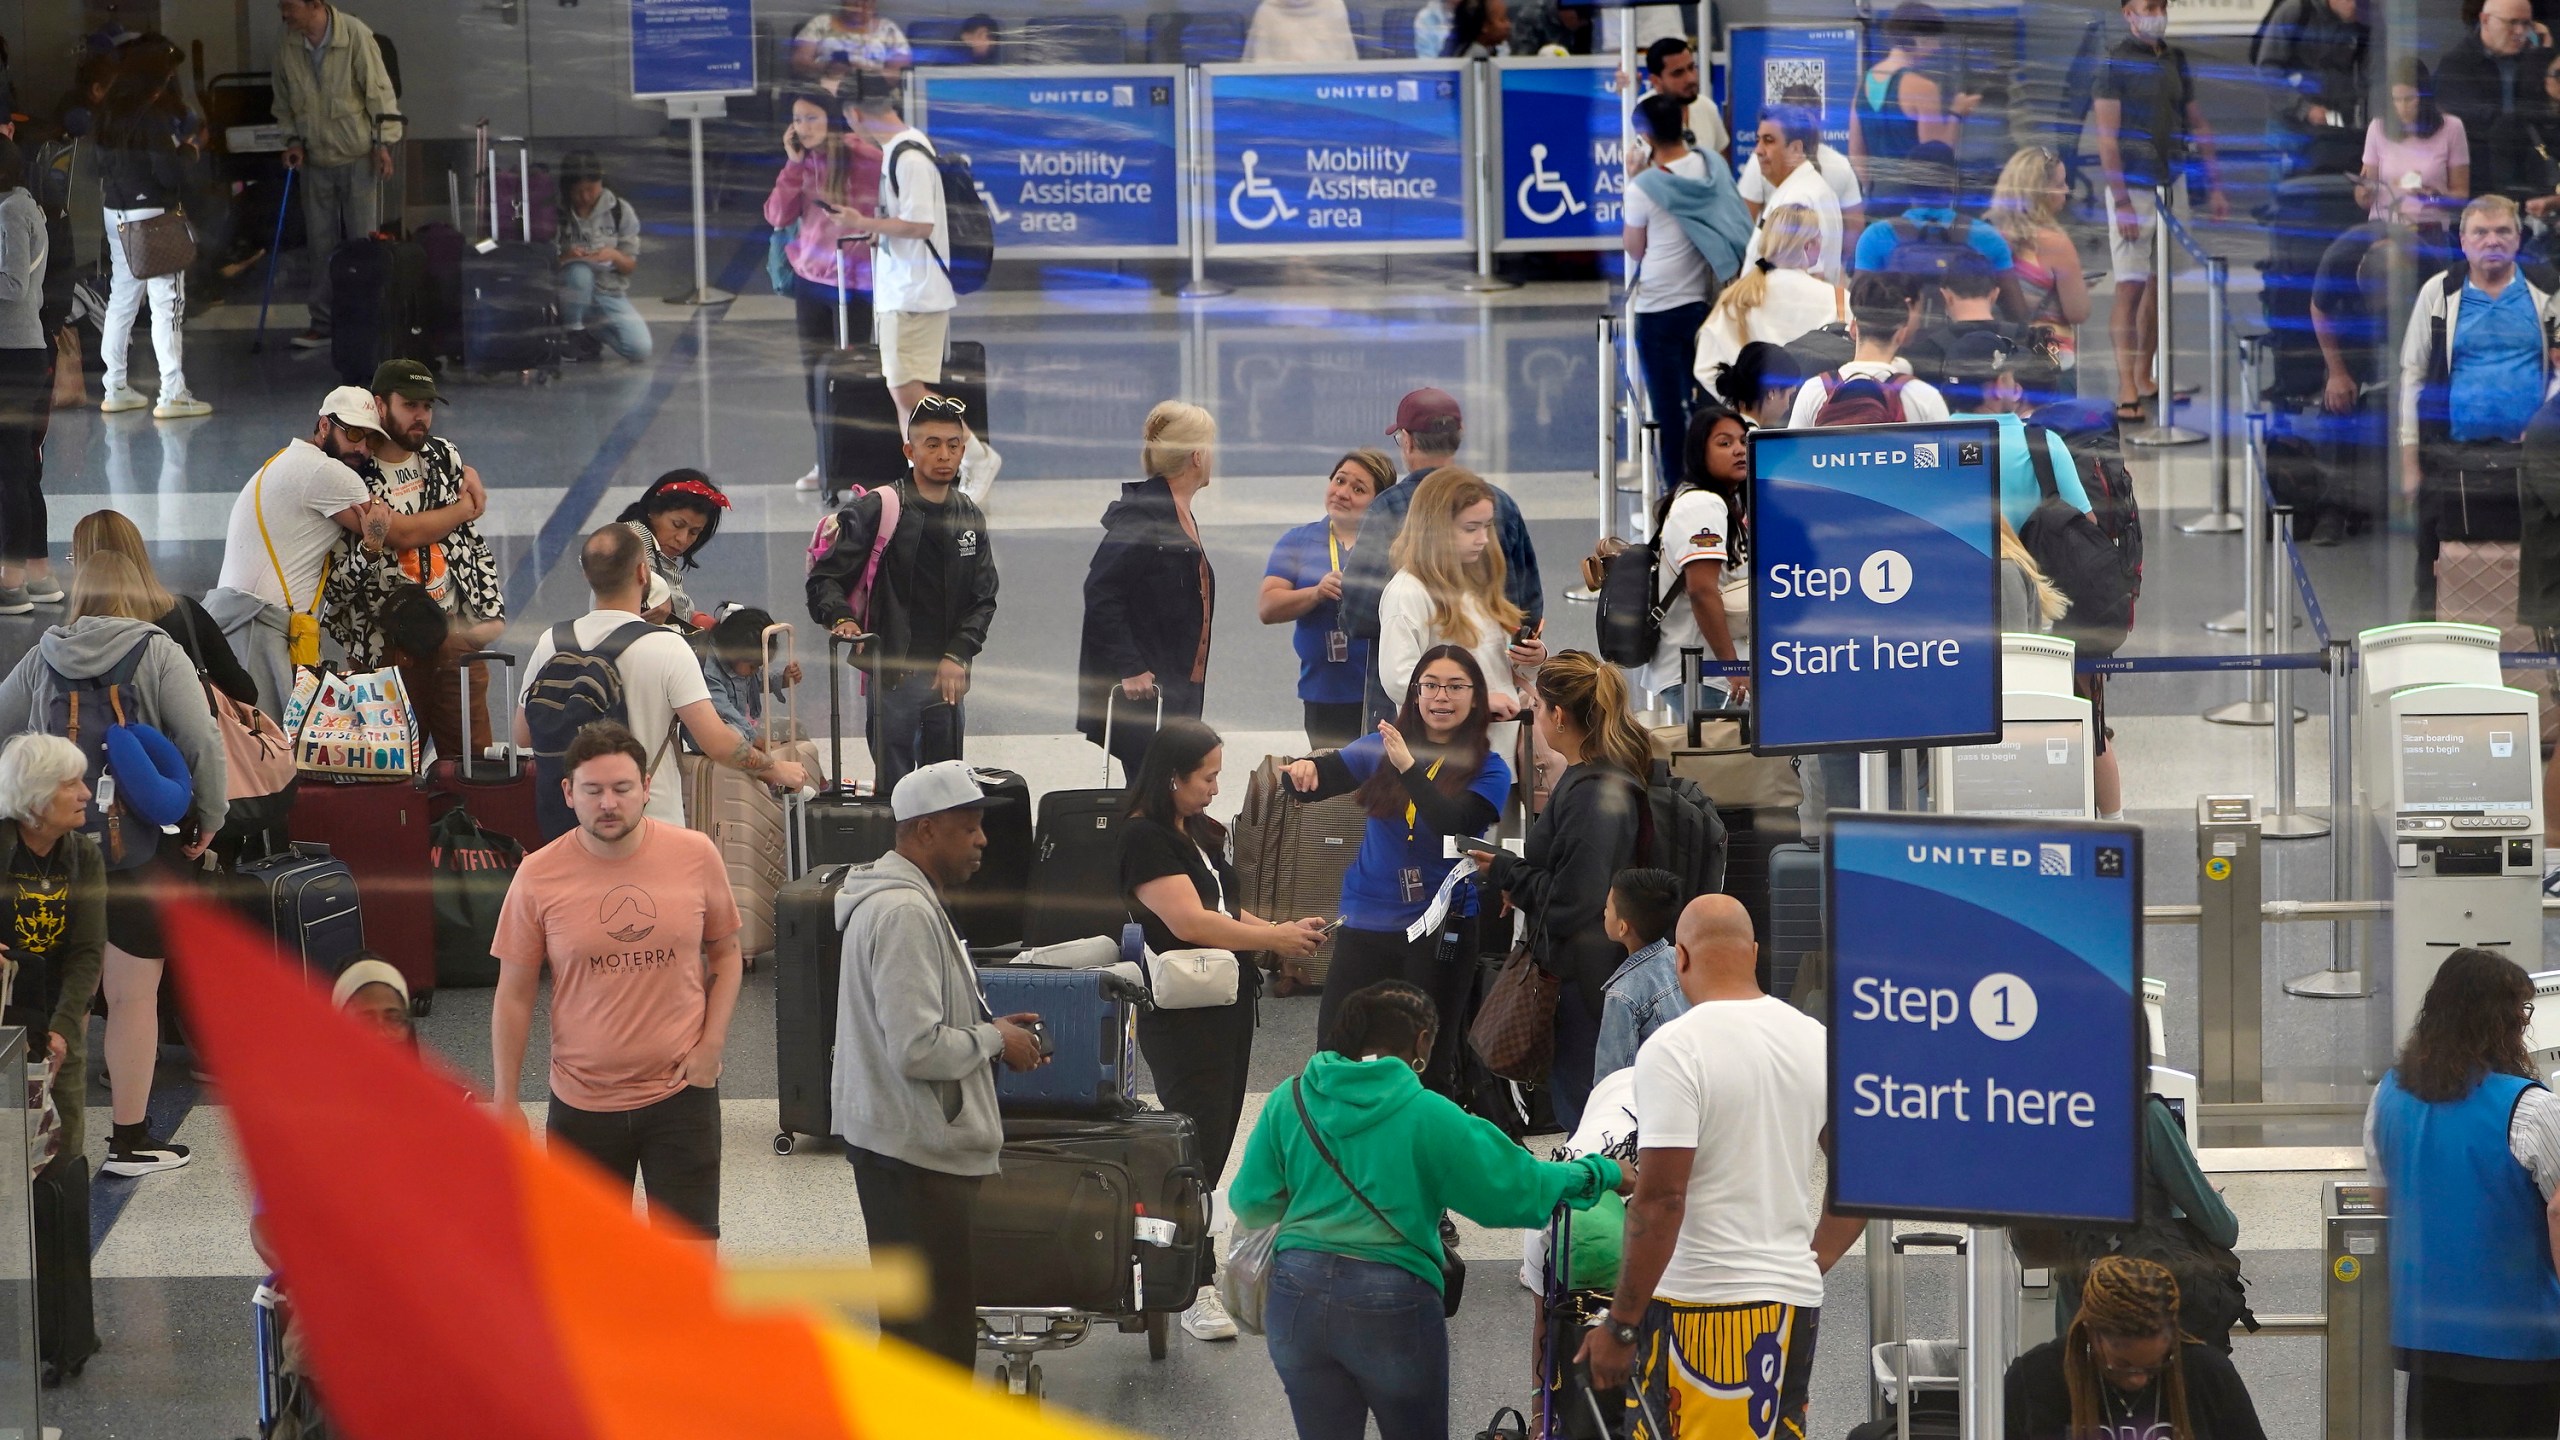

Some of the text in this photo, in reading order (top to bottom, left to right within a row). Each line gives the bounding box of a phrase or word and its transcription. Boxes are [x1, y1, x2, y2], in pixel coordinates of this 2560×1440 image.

[1029, 90, 1109, 103] UNITED
[1315, 85, 1394, 99] UNITED
[1019, 151, 1126, 179] Mobility
[1307, 146, 1410, 174] Mobility
[1019, 179, 1153, 204] Assistance
[1306, 175, 1438, 200] Assistance
[1020, 211, 1078, 232] area
[1308, 207, 1362, 228] area
[1812, 450, 1907, 469] UNITED
[1770, 559, 1896, 602] Step 1
[1771, 634, 1960, 677] Start here
[2426, 734, 2464, 743] boarding
[1957, 752, 2017, 762] pass to begin
[2426, 745, 2435, 753] to
[2436, 745, 2460, 755] begin
[1907, 845, 2032, 867] UNITED
[590, 948, 676, 969] MOTERRA
[1852, 976, 2016, 1031] Step 1
[1853, 1073, 2096, 1128] Start here
